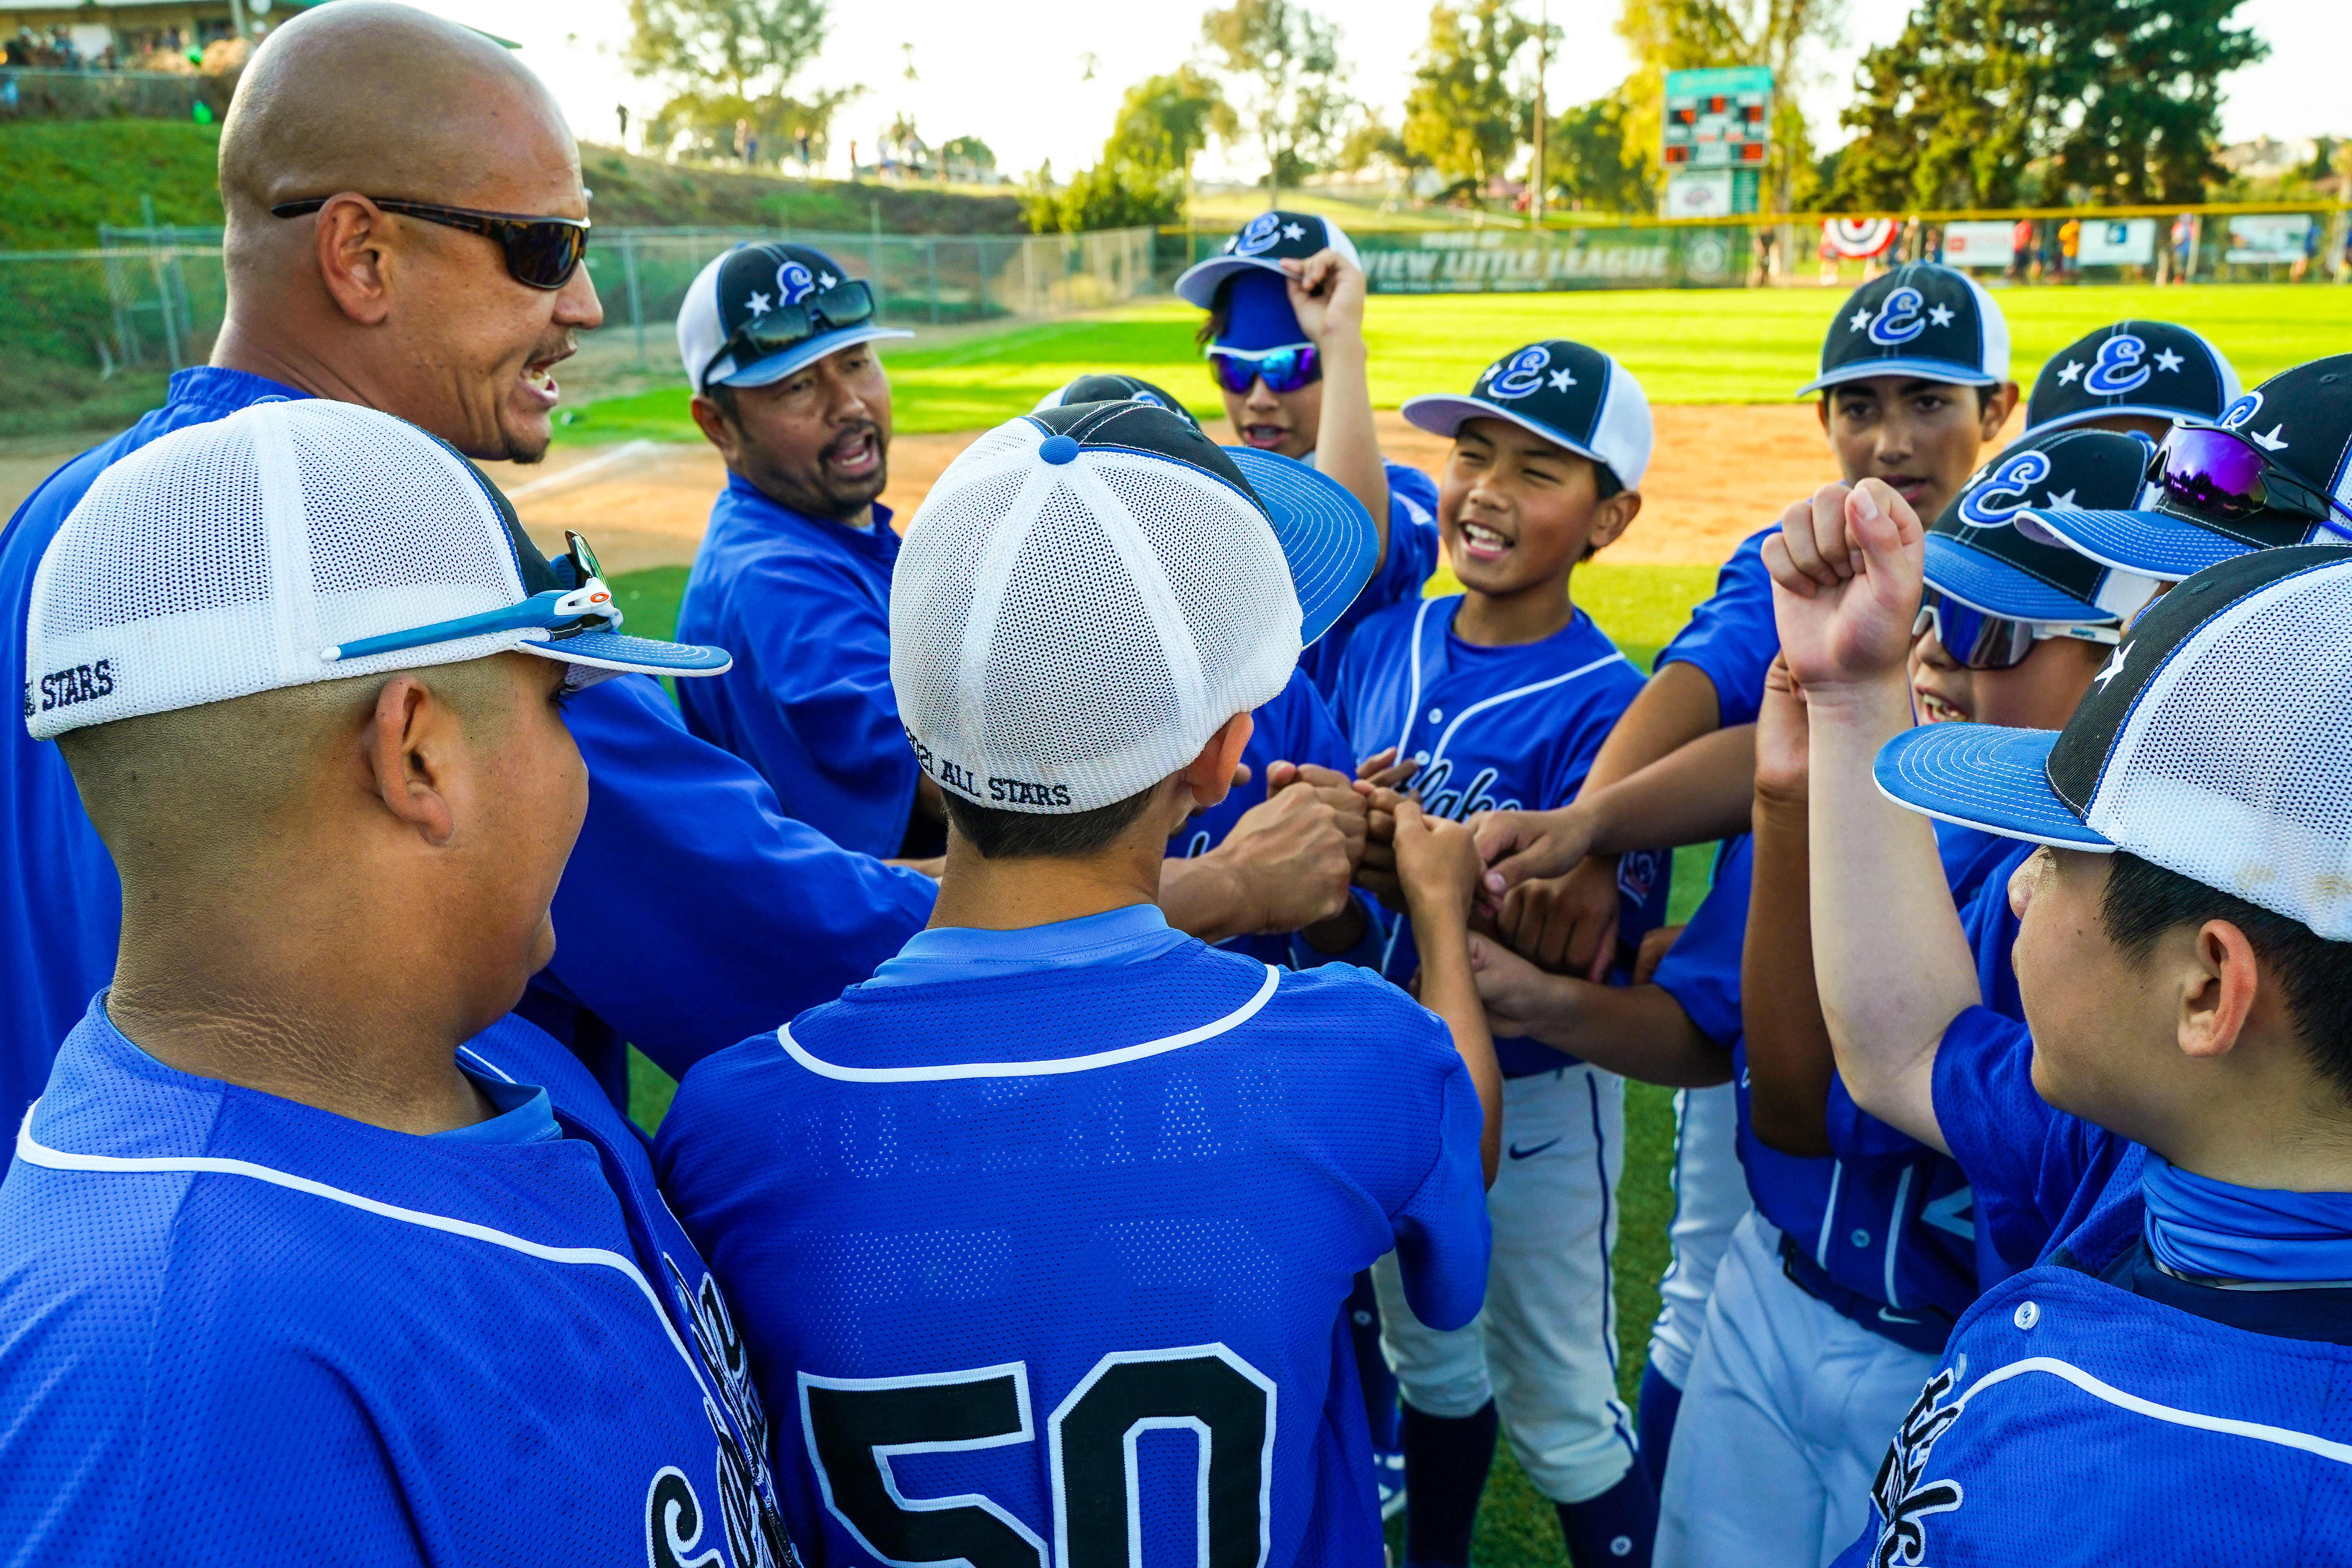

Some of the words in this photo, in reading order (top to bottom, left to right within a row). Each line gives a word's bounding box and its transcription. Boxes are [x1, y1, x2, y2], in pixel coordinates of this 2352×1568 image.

[1868, 286, 1926, 345] E
[1487, 345, 1551, 399] E
[2083, 334, 2152, 396] E
[1958, 449, 2051, 528] E
[40, 658, 114, 711] STARS
[941, 758, 981, 797] ALL
[988, 776, 1071, 807] STARS
[797, 1342, 1278, 1568] 50
